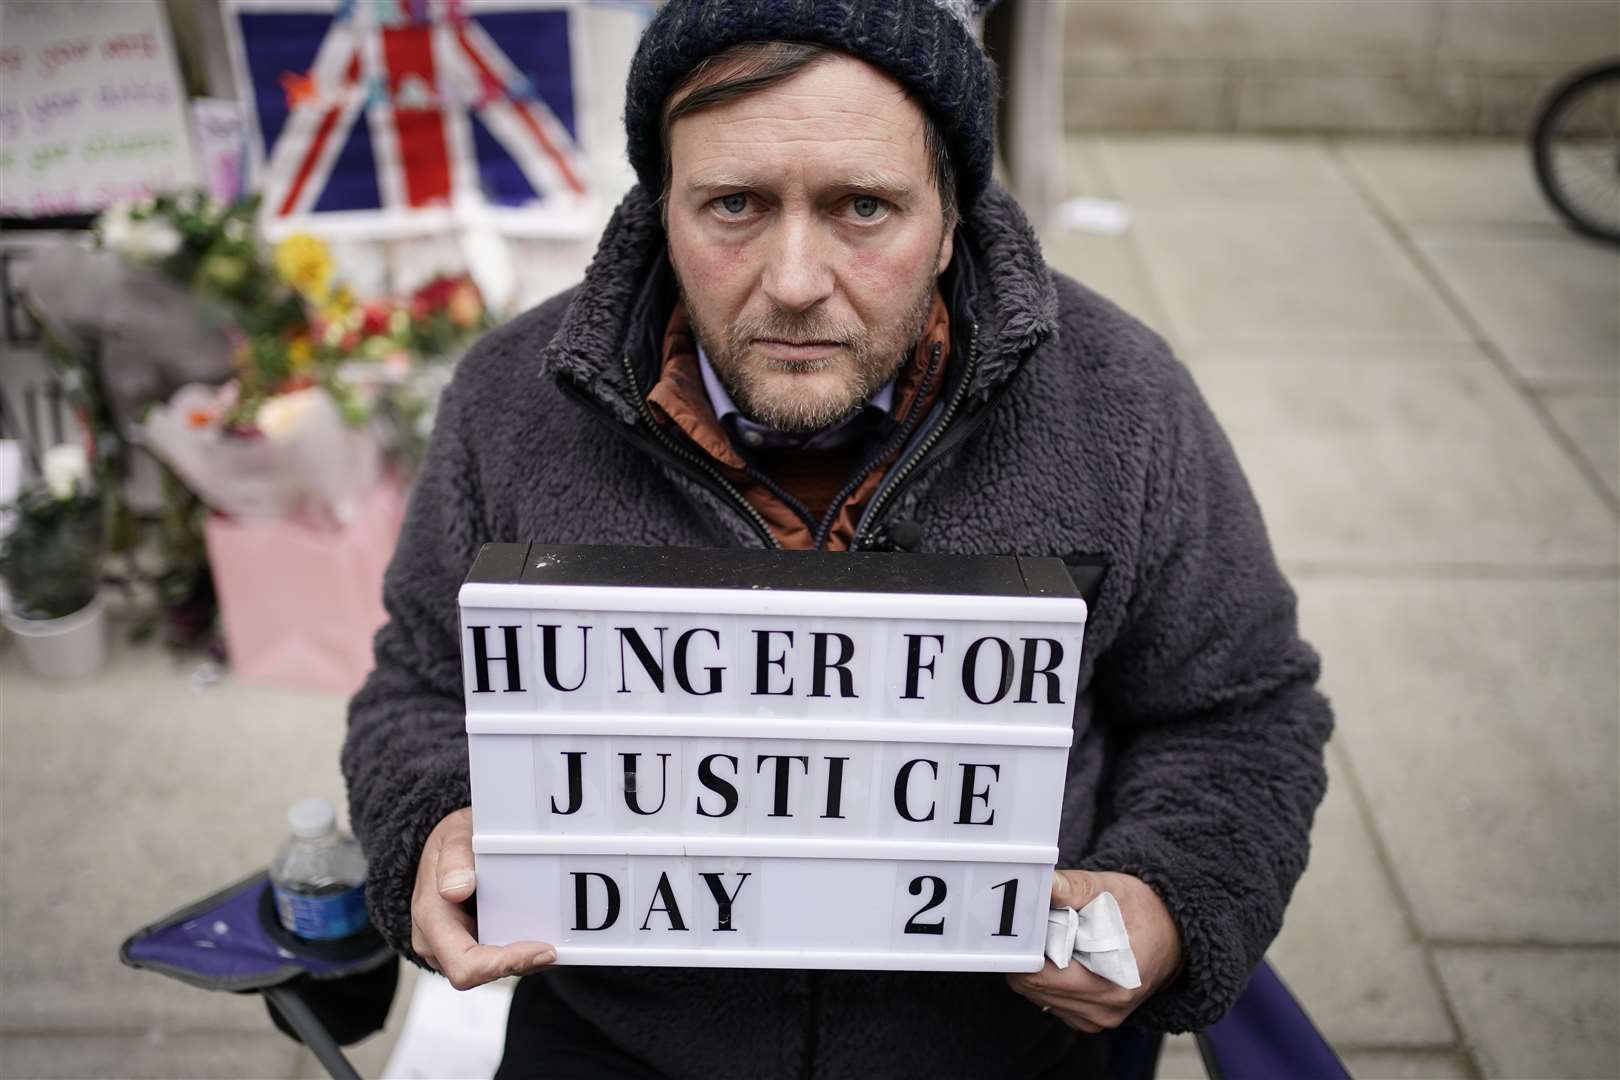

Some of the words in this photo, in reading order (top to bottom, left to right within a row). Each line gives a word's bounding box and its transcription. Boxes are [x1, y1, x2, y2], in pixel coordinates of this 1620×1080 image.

[466, 623, 860, 699] HUNGER
[899, 633, 1066, 705] FOR
[550, 751, 1001, 826] JUSTICE
[569, 871, 752, 932] DAY
[903, 875, 1019, 938] 21
